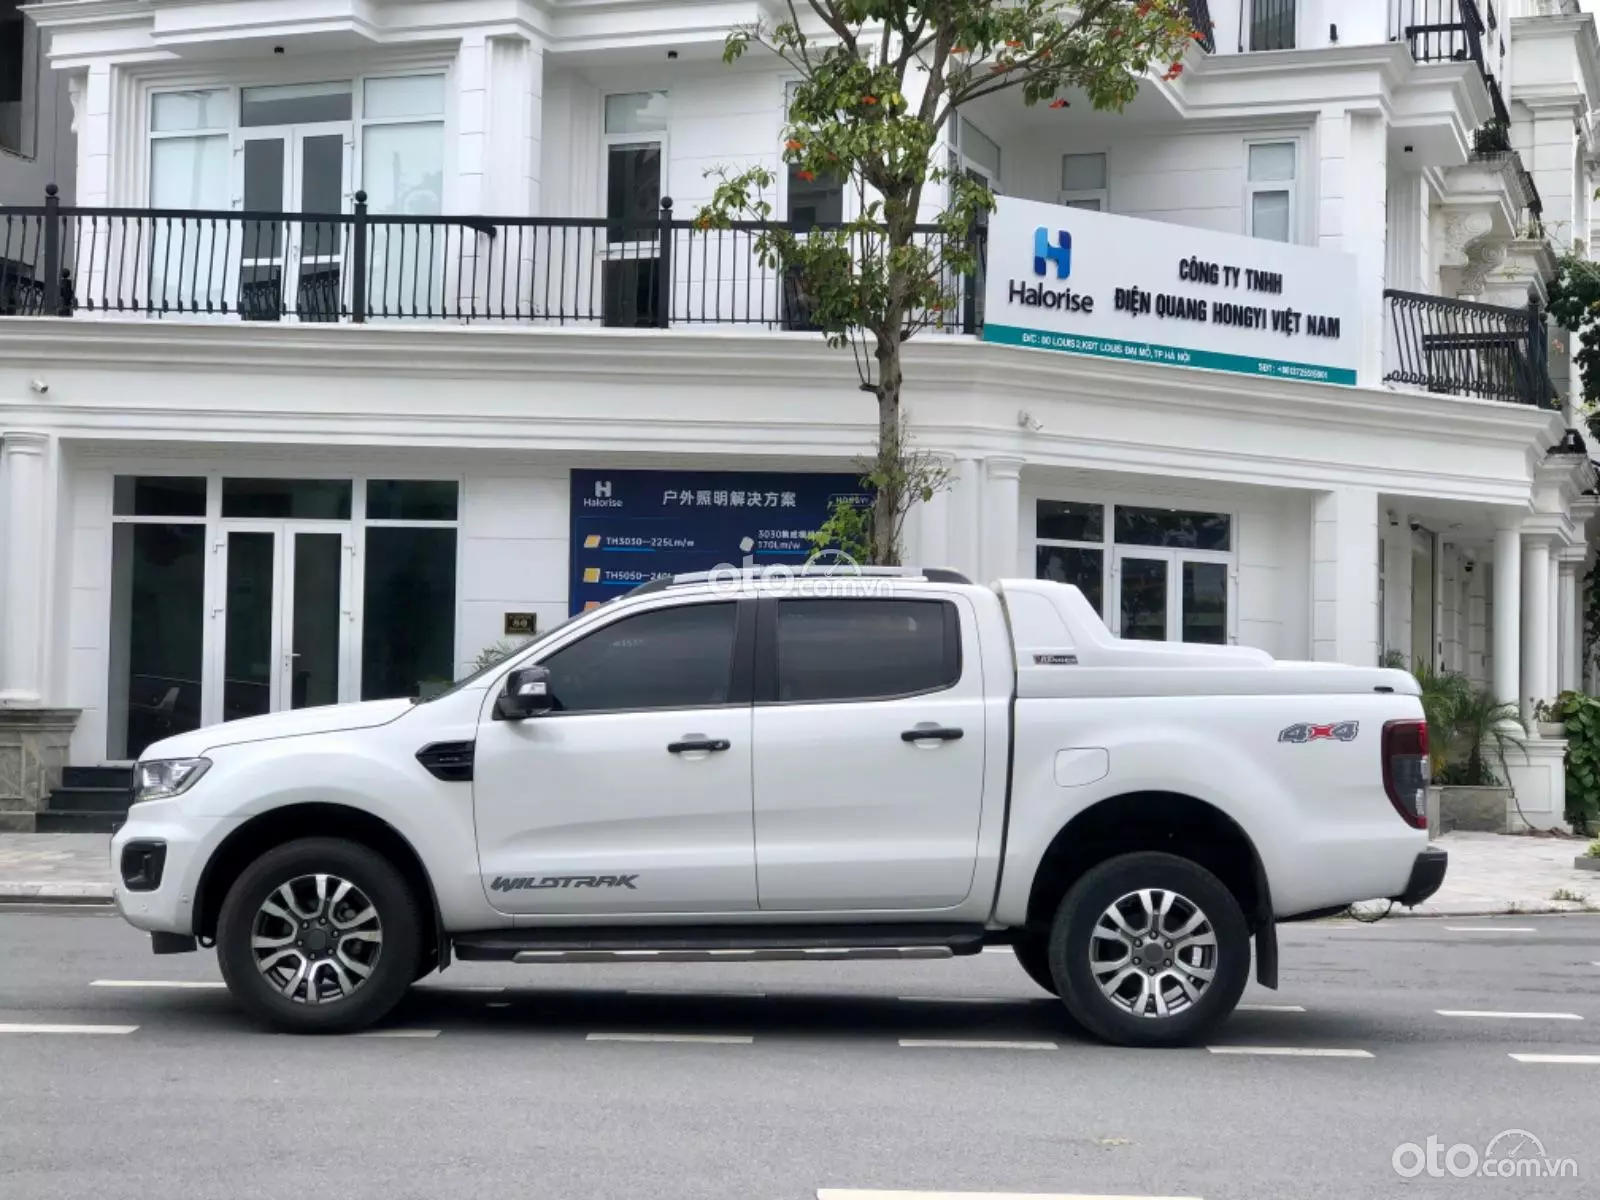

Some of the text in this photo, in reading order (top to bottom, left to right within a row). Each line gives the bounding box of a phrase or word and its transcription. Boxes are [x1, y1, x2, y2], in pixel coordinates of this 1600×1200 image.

[1179, 256, 1283, 295] CÔNG TY TNHH
[1008, 279, 1094, 314] Halorise
[1114, 285, 1340, 339] ĐIỆN QUANG HONGYI VIỆT NAM
[1100, 342, 1122, 353] LOUIS
[583, 498, 624, 508] Halorise
[662, 489, 797, 507] 户外照明解决方案
[490, 874, 640, 892] WILDTRAK
